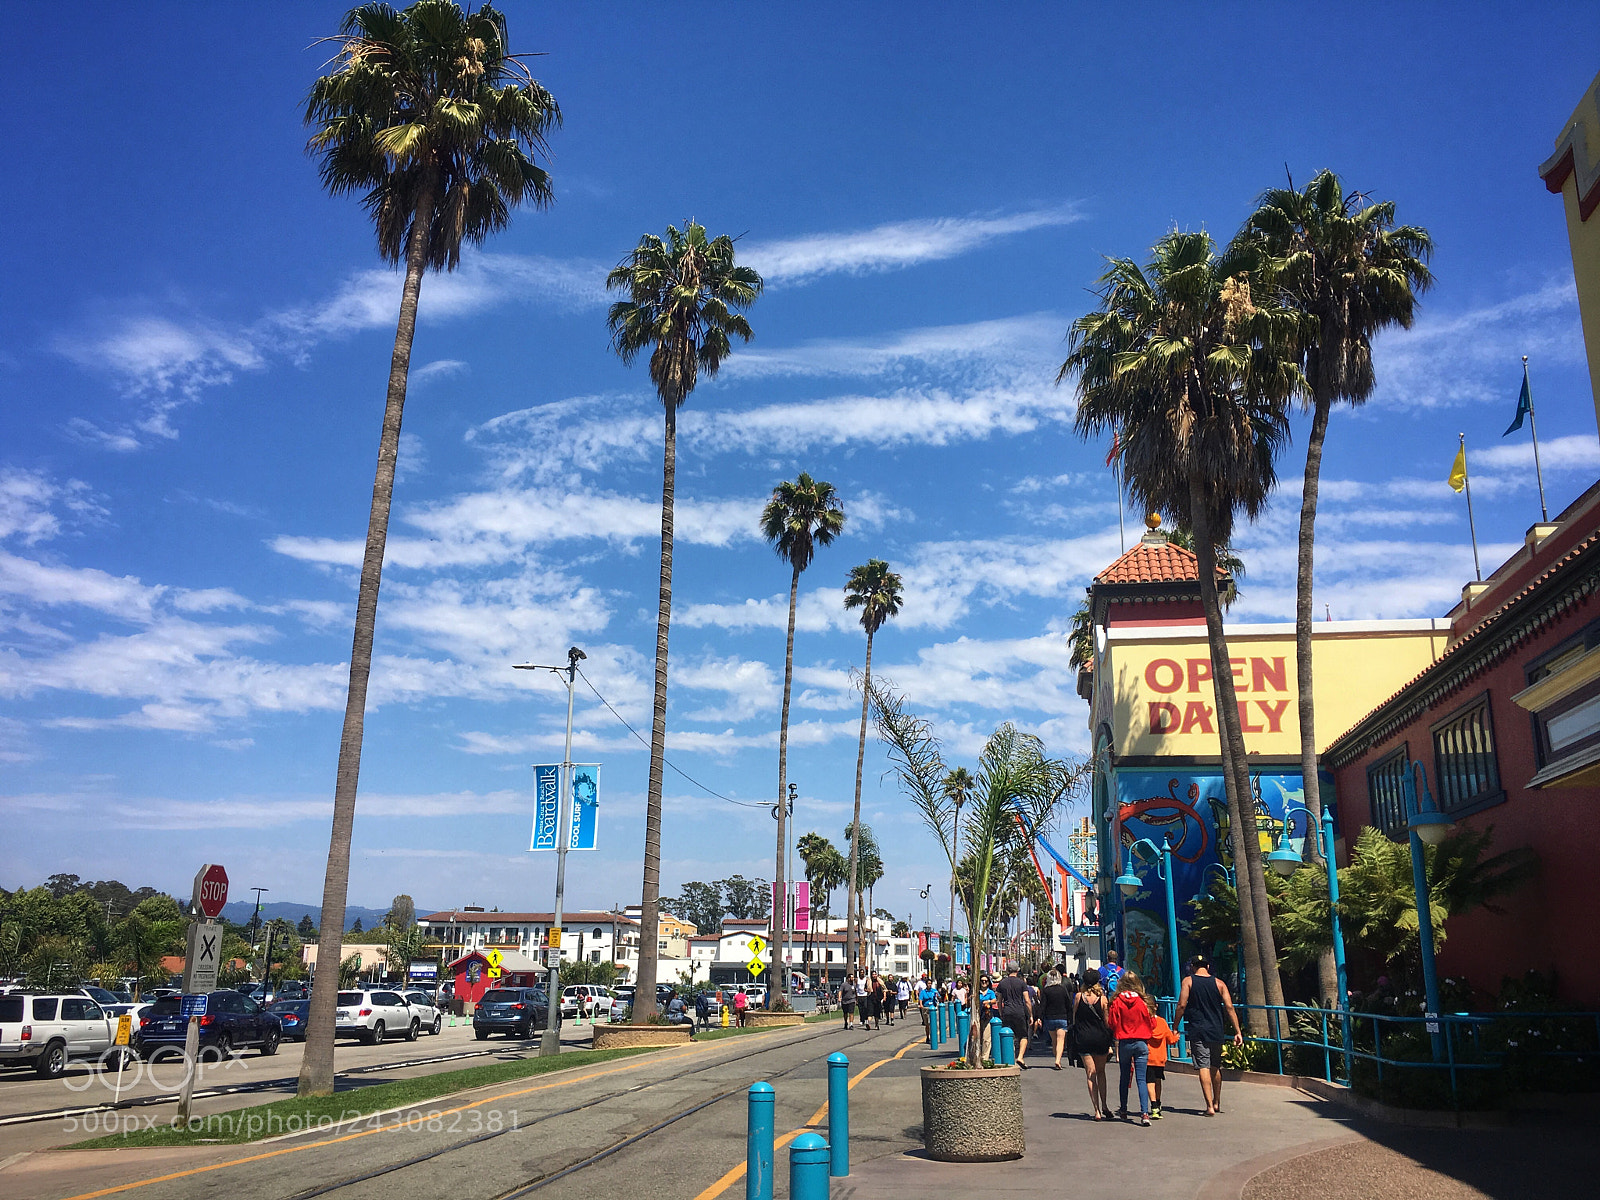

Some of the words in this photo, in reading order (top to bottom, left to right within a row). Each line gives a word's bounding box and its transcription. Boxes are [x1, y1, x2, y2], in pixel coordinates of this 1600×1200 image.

[1144, 656, 1289, 694] OPEN
[1147, 699, 1291, 735] DALY
[537, 767, 556, 848] Boardwalk
[574, 802, 582, 822] SURF
[572, 824, 580, 847] COOL
[202, 880, 227, 901] STOP
